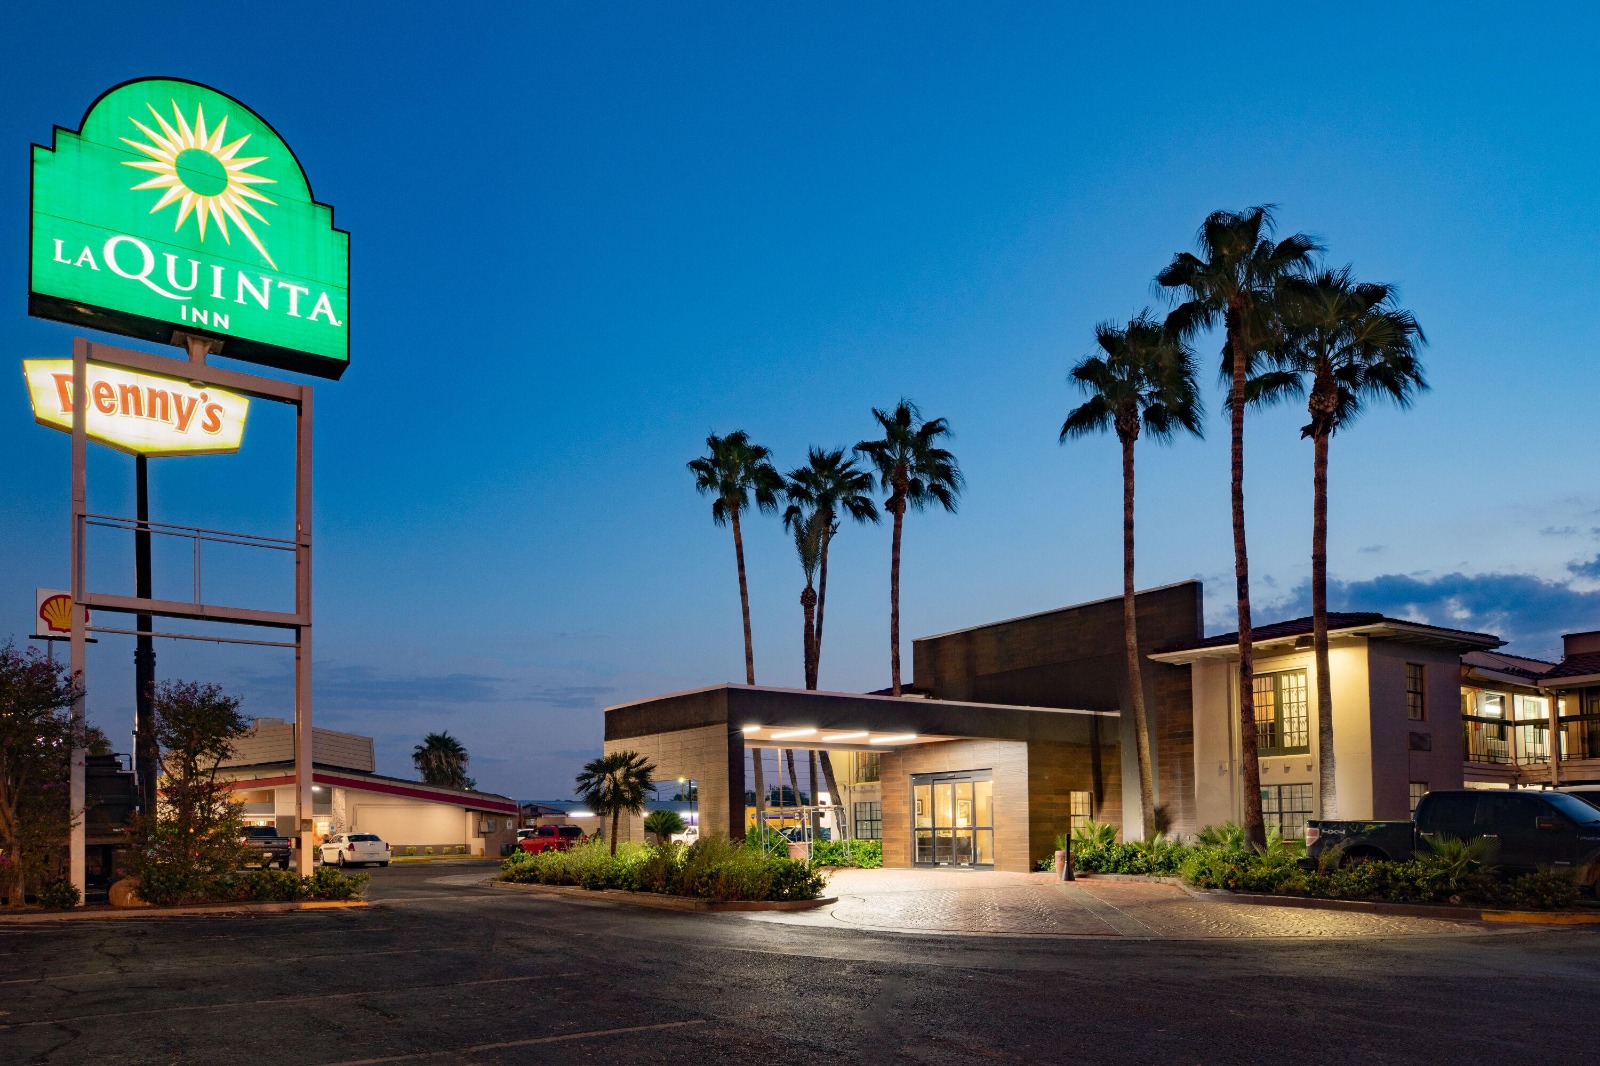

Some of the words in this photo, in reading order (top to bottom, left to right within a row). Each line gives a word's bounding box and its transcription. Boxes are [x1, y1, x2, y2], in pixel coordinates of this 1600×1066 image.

[52, 238, 101, 271] LA
[103, 235, 343, 327] QUINTA
[181, 304, 229, 330] INN
[51, 373, 226, 435] Denny's
